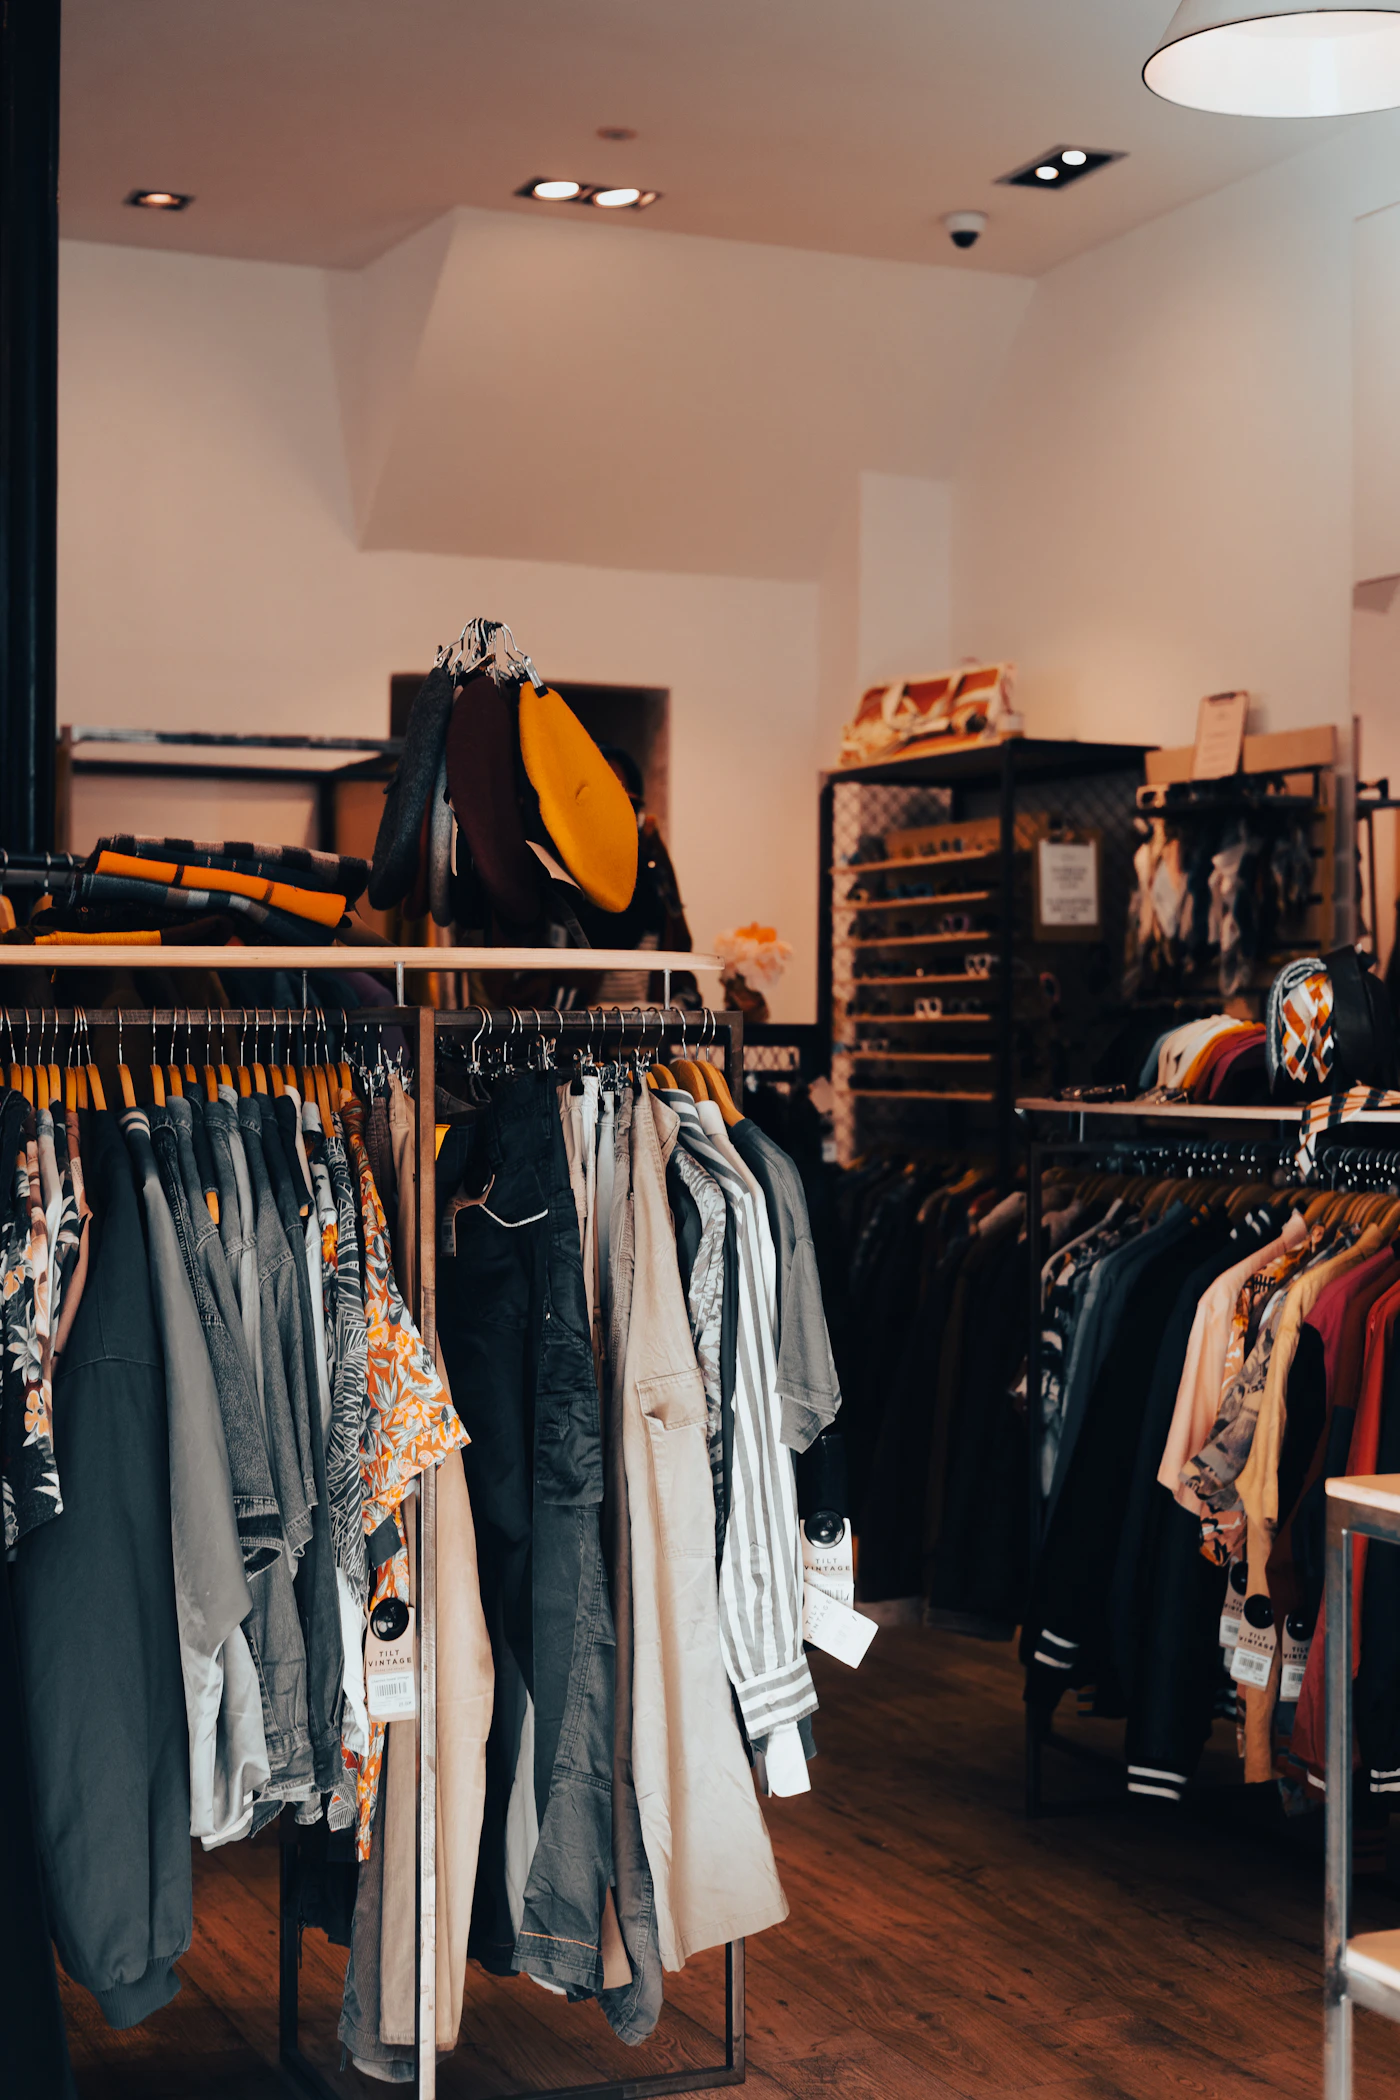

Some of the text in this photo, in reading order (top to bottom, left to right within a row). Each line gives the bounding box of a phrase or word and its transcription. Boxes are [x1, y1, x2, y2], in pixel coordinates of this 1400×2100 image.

[805, 1605, 820, 1625] TILT
[807, 1599, 832, 1640] VINTAGE
[1249, 1632, 1267, 1641] TILT
[1239, 1636, 1274, 1651] VINTAGE
[379, 1649, 399, 1657] TILT
[368, 1657, 412, 1667] VINTAGE
